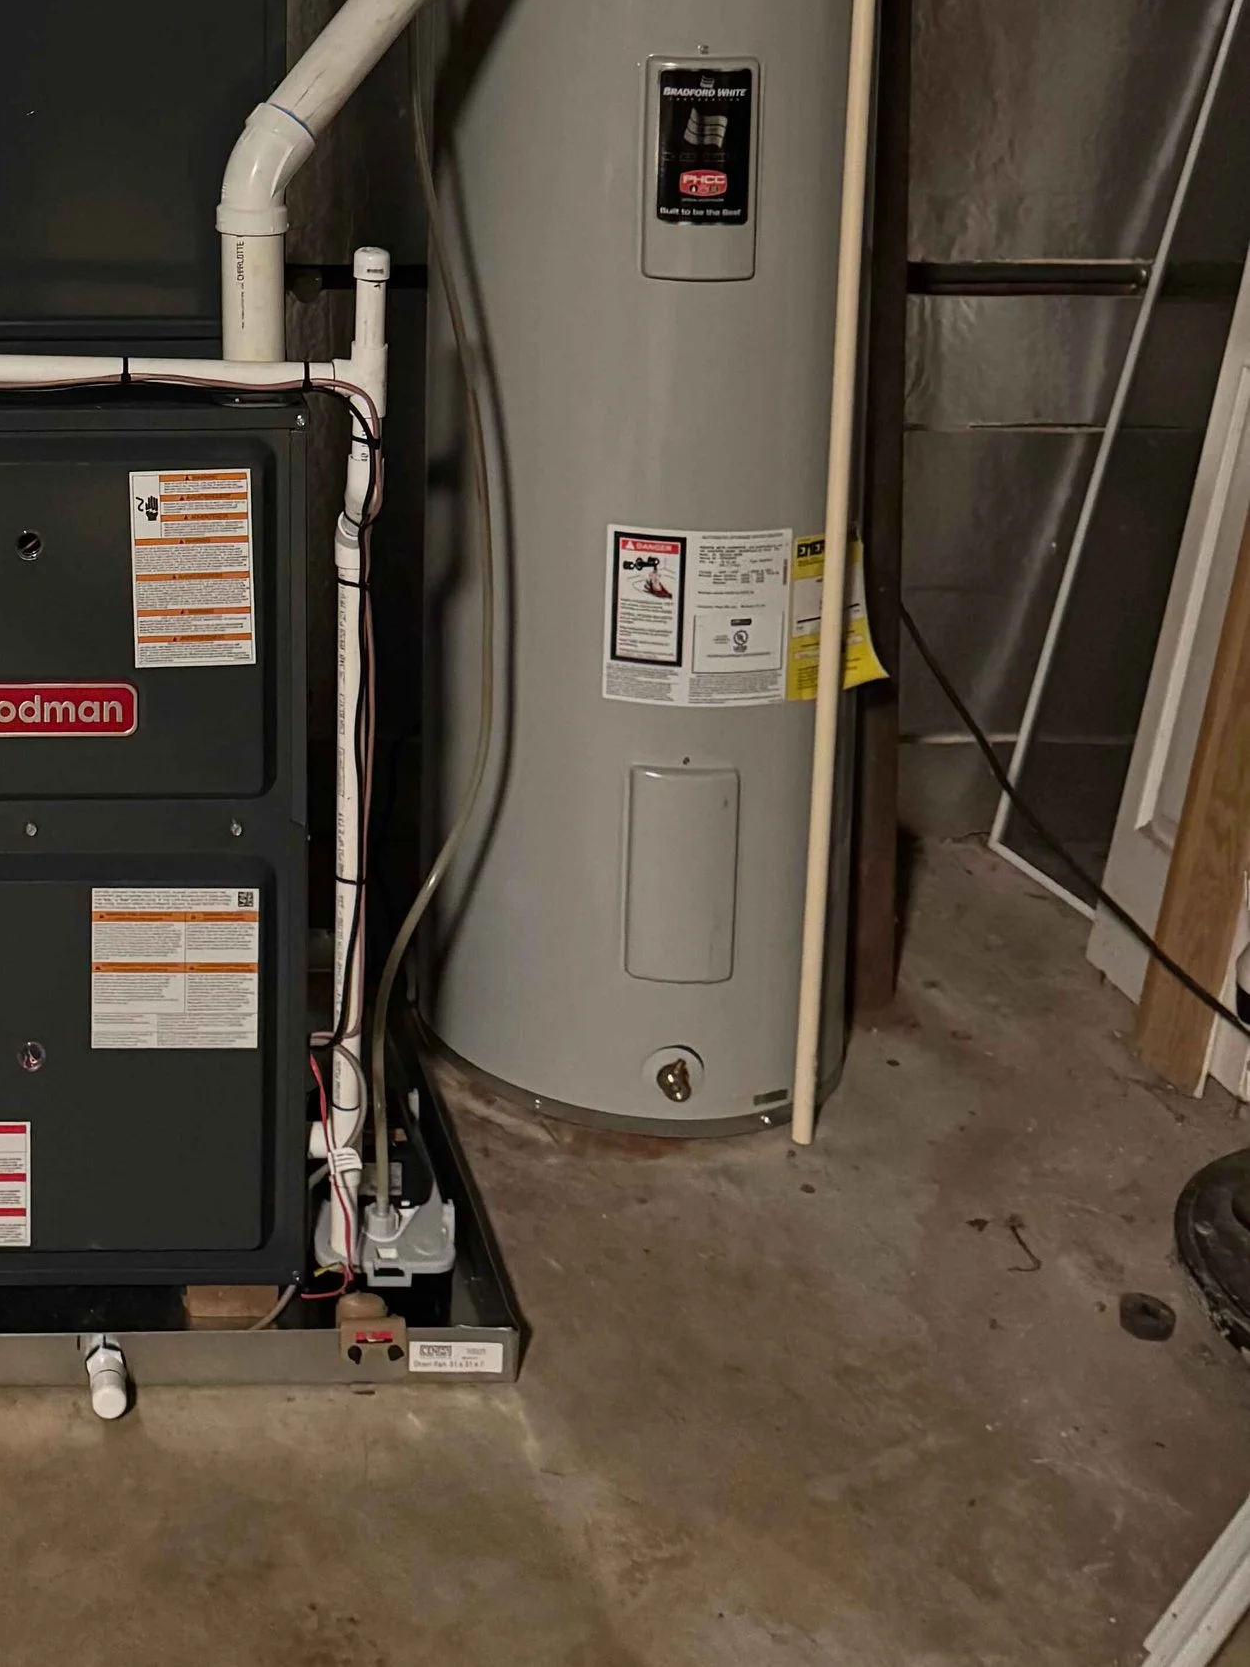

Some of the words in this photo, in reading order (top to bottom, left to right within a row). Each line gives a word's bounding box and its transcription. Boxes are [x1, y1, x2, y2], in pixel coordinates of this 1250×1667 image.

[662, 87, 716, 97] BRADFORD
[718, 88, 748, 97] WHITE
[683, 175, 725, 184] PHCC
[660, 206, 680, 214] Built
[693, 208, 704, 216] be
